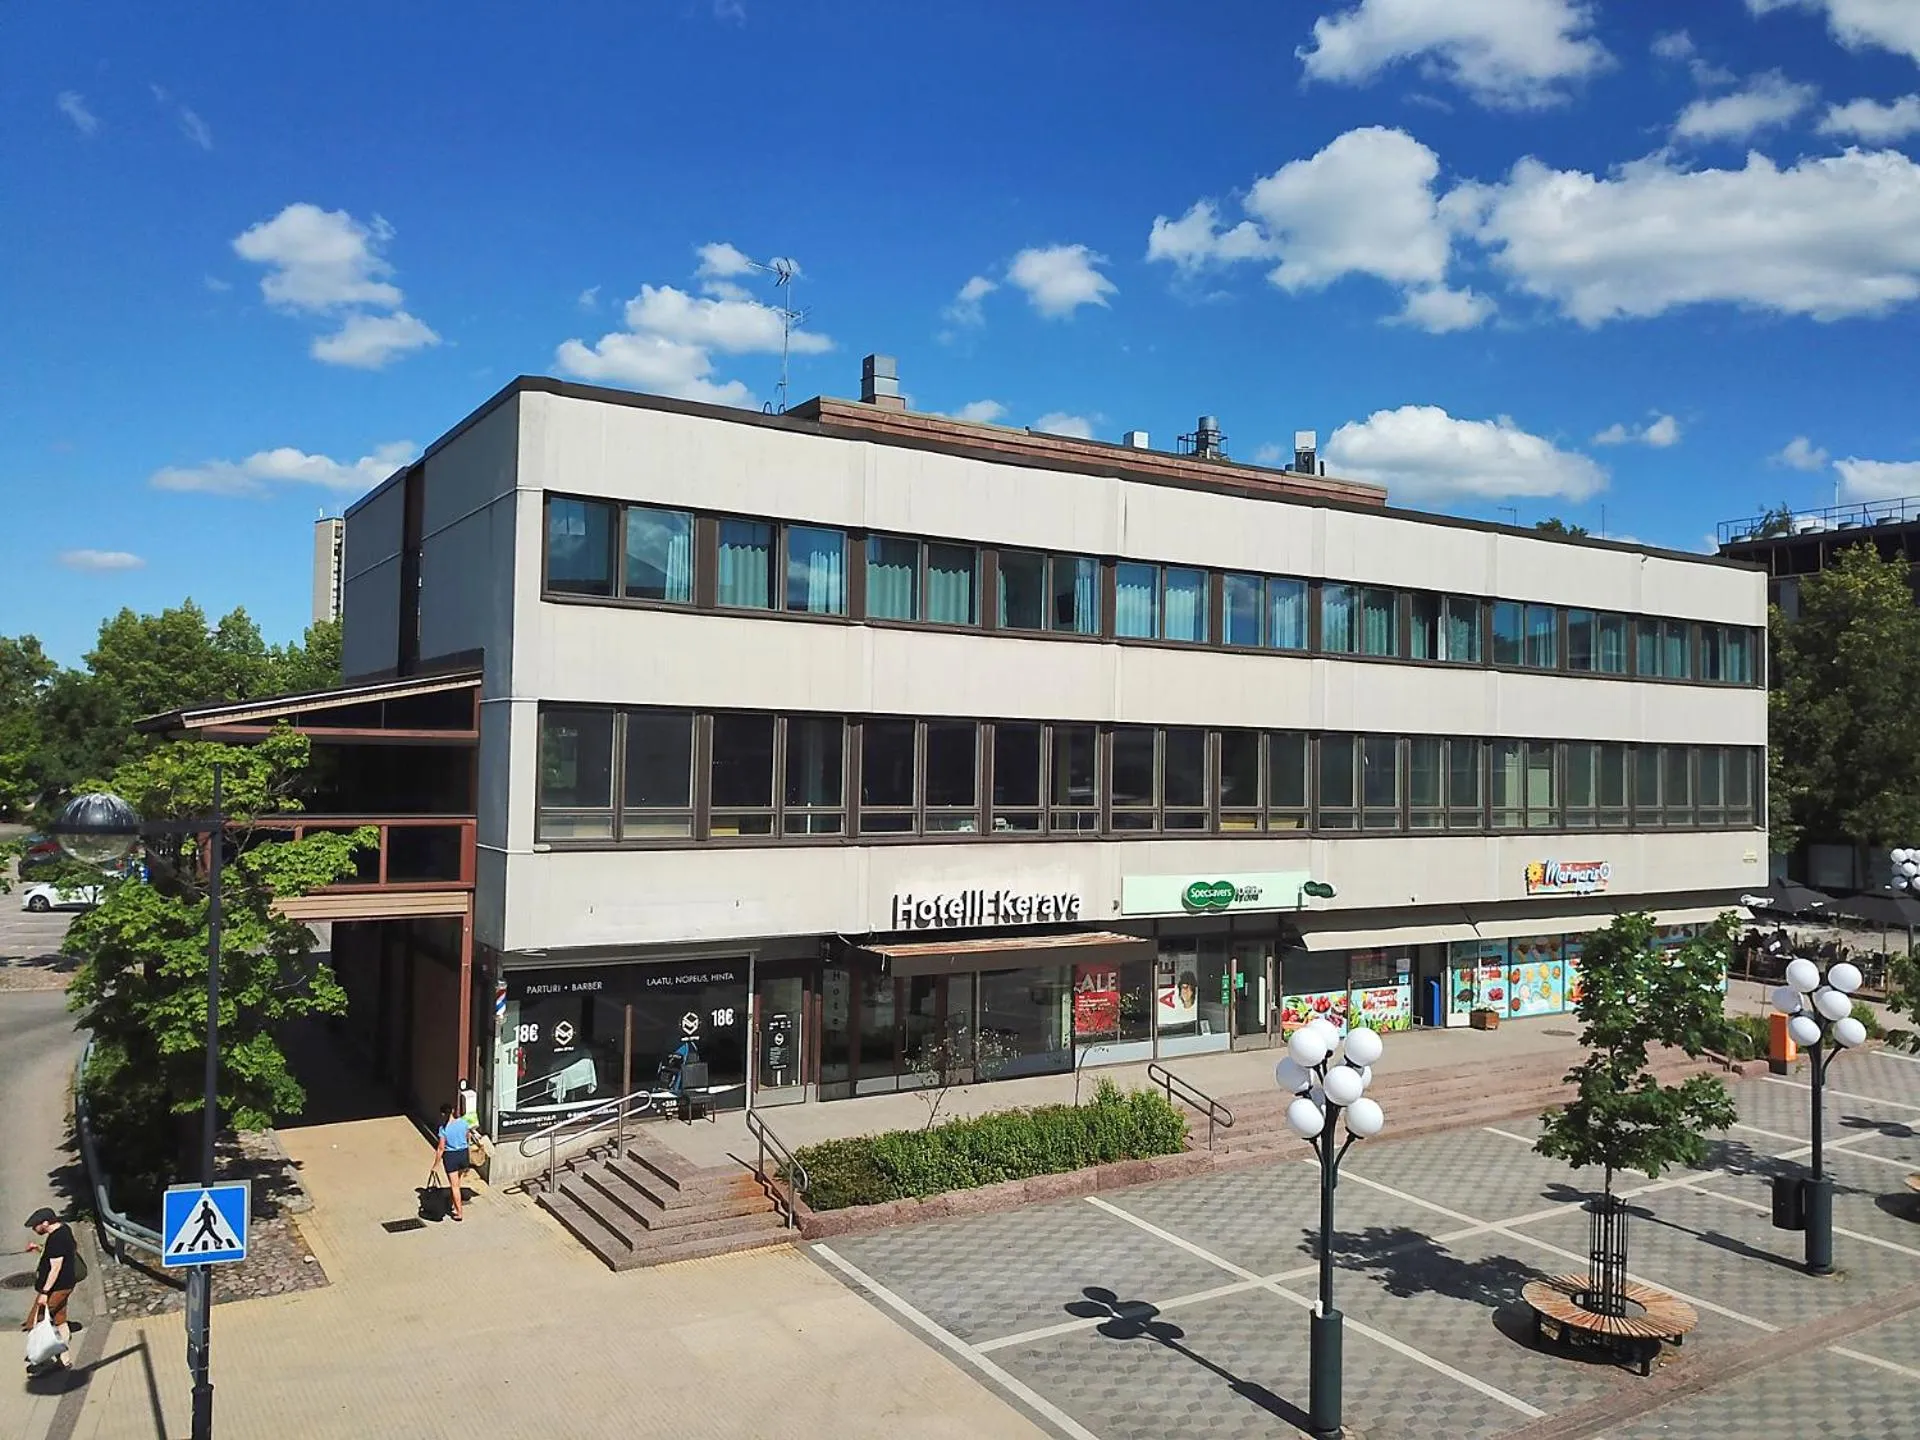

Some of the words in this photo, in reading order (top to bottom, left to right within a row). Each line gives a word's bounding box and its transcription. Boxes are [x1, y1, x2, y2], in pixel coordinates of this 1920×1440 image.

[1190, 887, 1232, 899] Specsavers
[997, 888, 1082, 923] Kerava
[711, 972, 735, 981] HINTA
[1160, 961, 1176, 1009] ALE
[526, 984, 561, 995] PARTURI
[571, 981, 603, 992] BARBER
[711, 1008, 735, 1027] 18€
[513, 1023, 540, 1043] 18€
